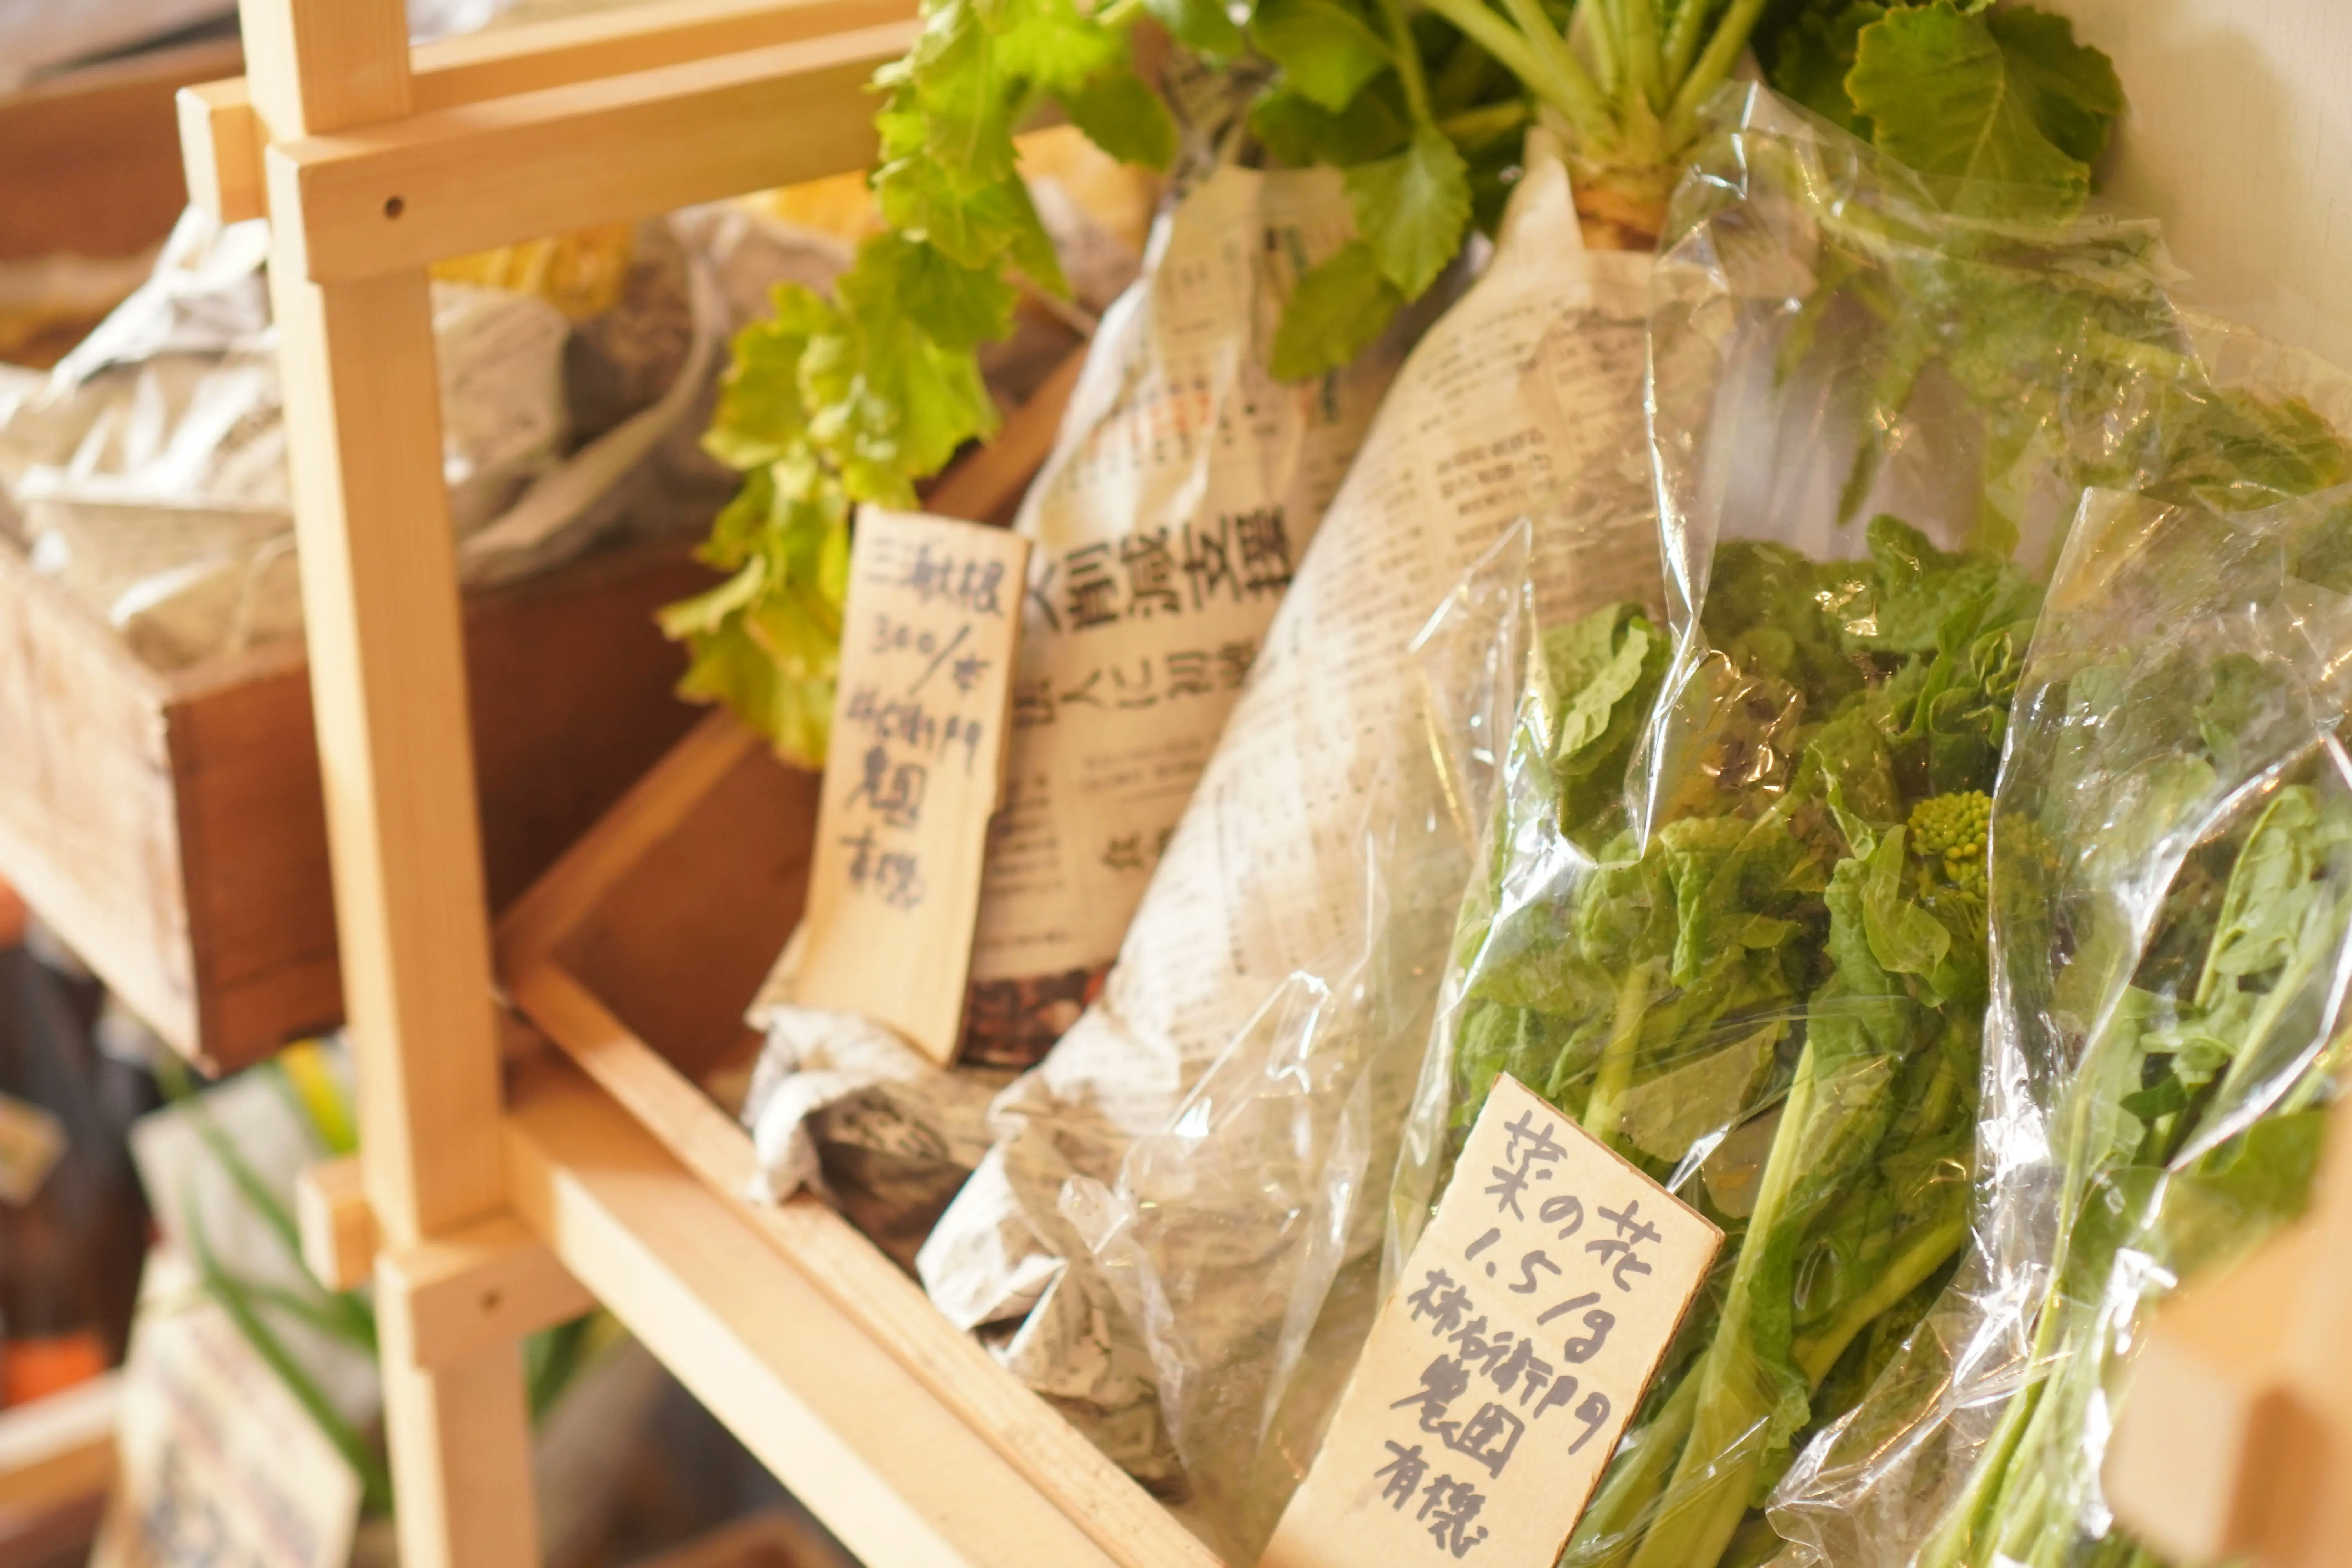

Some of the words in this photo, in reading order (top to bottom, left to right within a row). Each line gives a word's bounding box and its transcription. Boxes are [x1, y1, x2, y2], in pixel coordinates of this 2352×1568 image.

[1485, 1109, 1662, 1292] 菜の花
[1390, 1354, 1525, 1479] 農園
[1374, 1439, 1488, 1559] 有機
